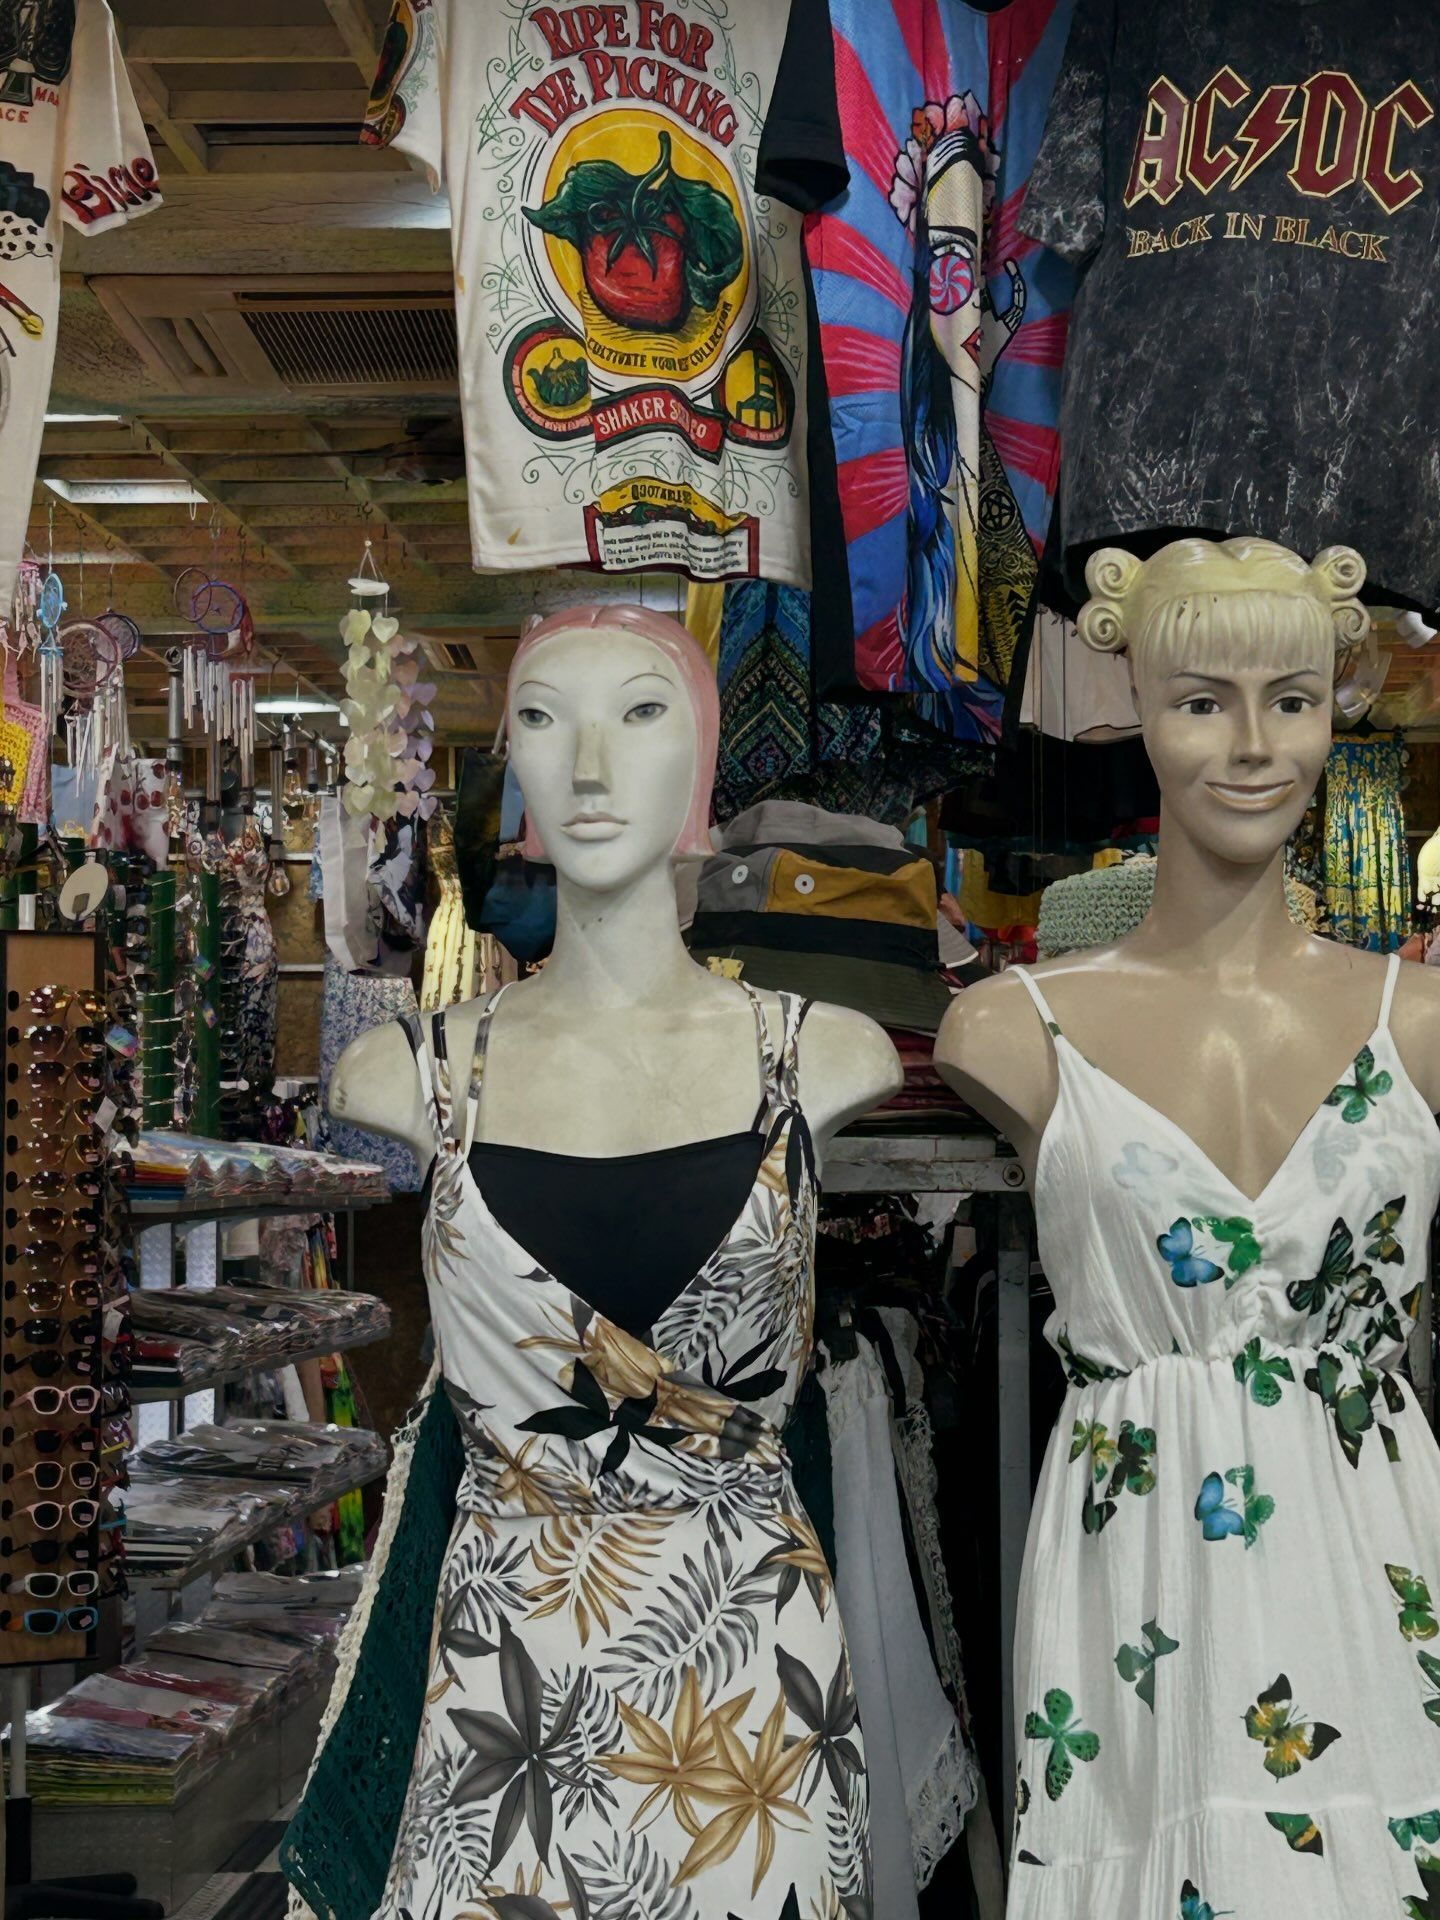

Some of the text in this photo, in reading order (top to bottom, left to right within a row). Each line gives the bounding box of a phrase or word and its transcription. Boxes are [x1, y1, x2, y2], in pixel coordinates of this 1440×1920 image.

[529, 0, 714, 73] RIPE FOR
[508, 49, 739, 147] THE PICKING
[1125, 211, 1390, 263] BACK IN BLACK
[587, 301, 733, 372] CULTIVATE YOUR COLLECTION
[596, 397, 667, 435] SHAKER
